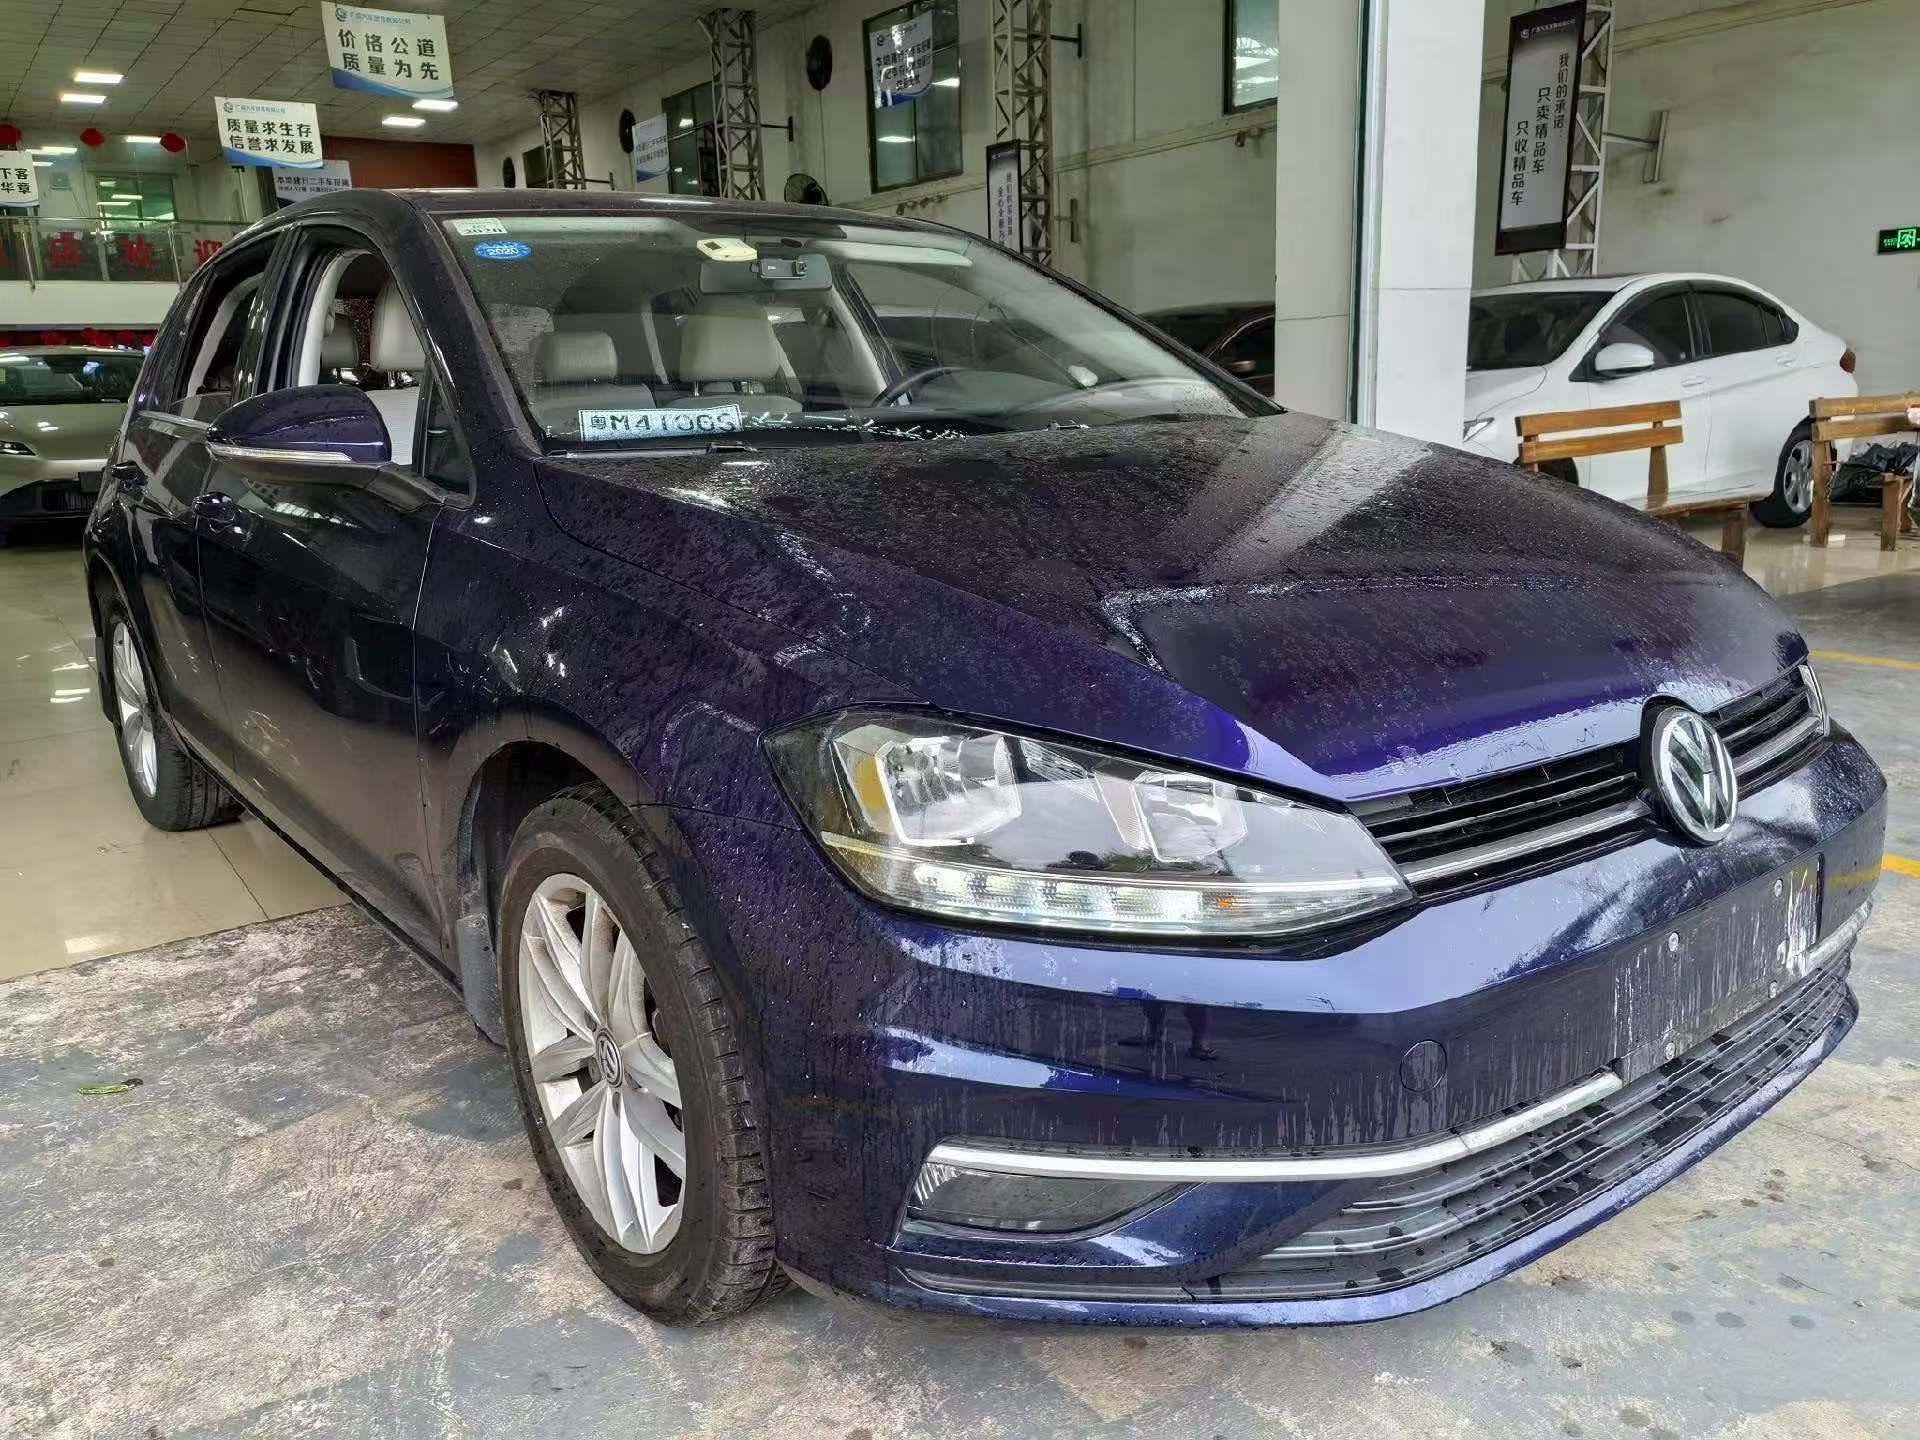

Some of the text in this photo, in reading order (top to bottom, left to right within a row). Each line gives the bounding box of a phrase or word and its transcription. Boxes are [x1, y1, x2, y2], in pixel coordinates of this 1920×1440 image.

[337, 28, 436, 58] 价格公道
[342, 52, 439, 80] 质量为先
[226, 118, 312, 138] 质量求生存
[1531, 86, 1551, 175] 只卖精品车
[229, 135, 315, 155] 信誉求发展
[0, 167, 28, 180] 下客
[1511, 120, 1529, 206] 只收精品车
[1, 181, 31, 194] 华章
